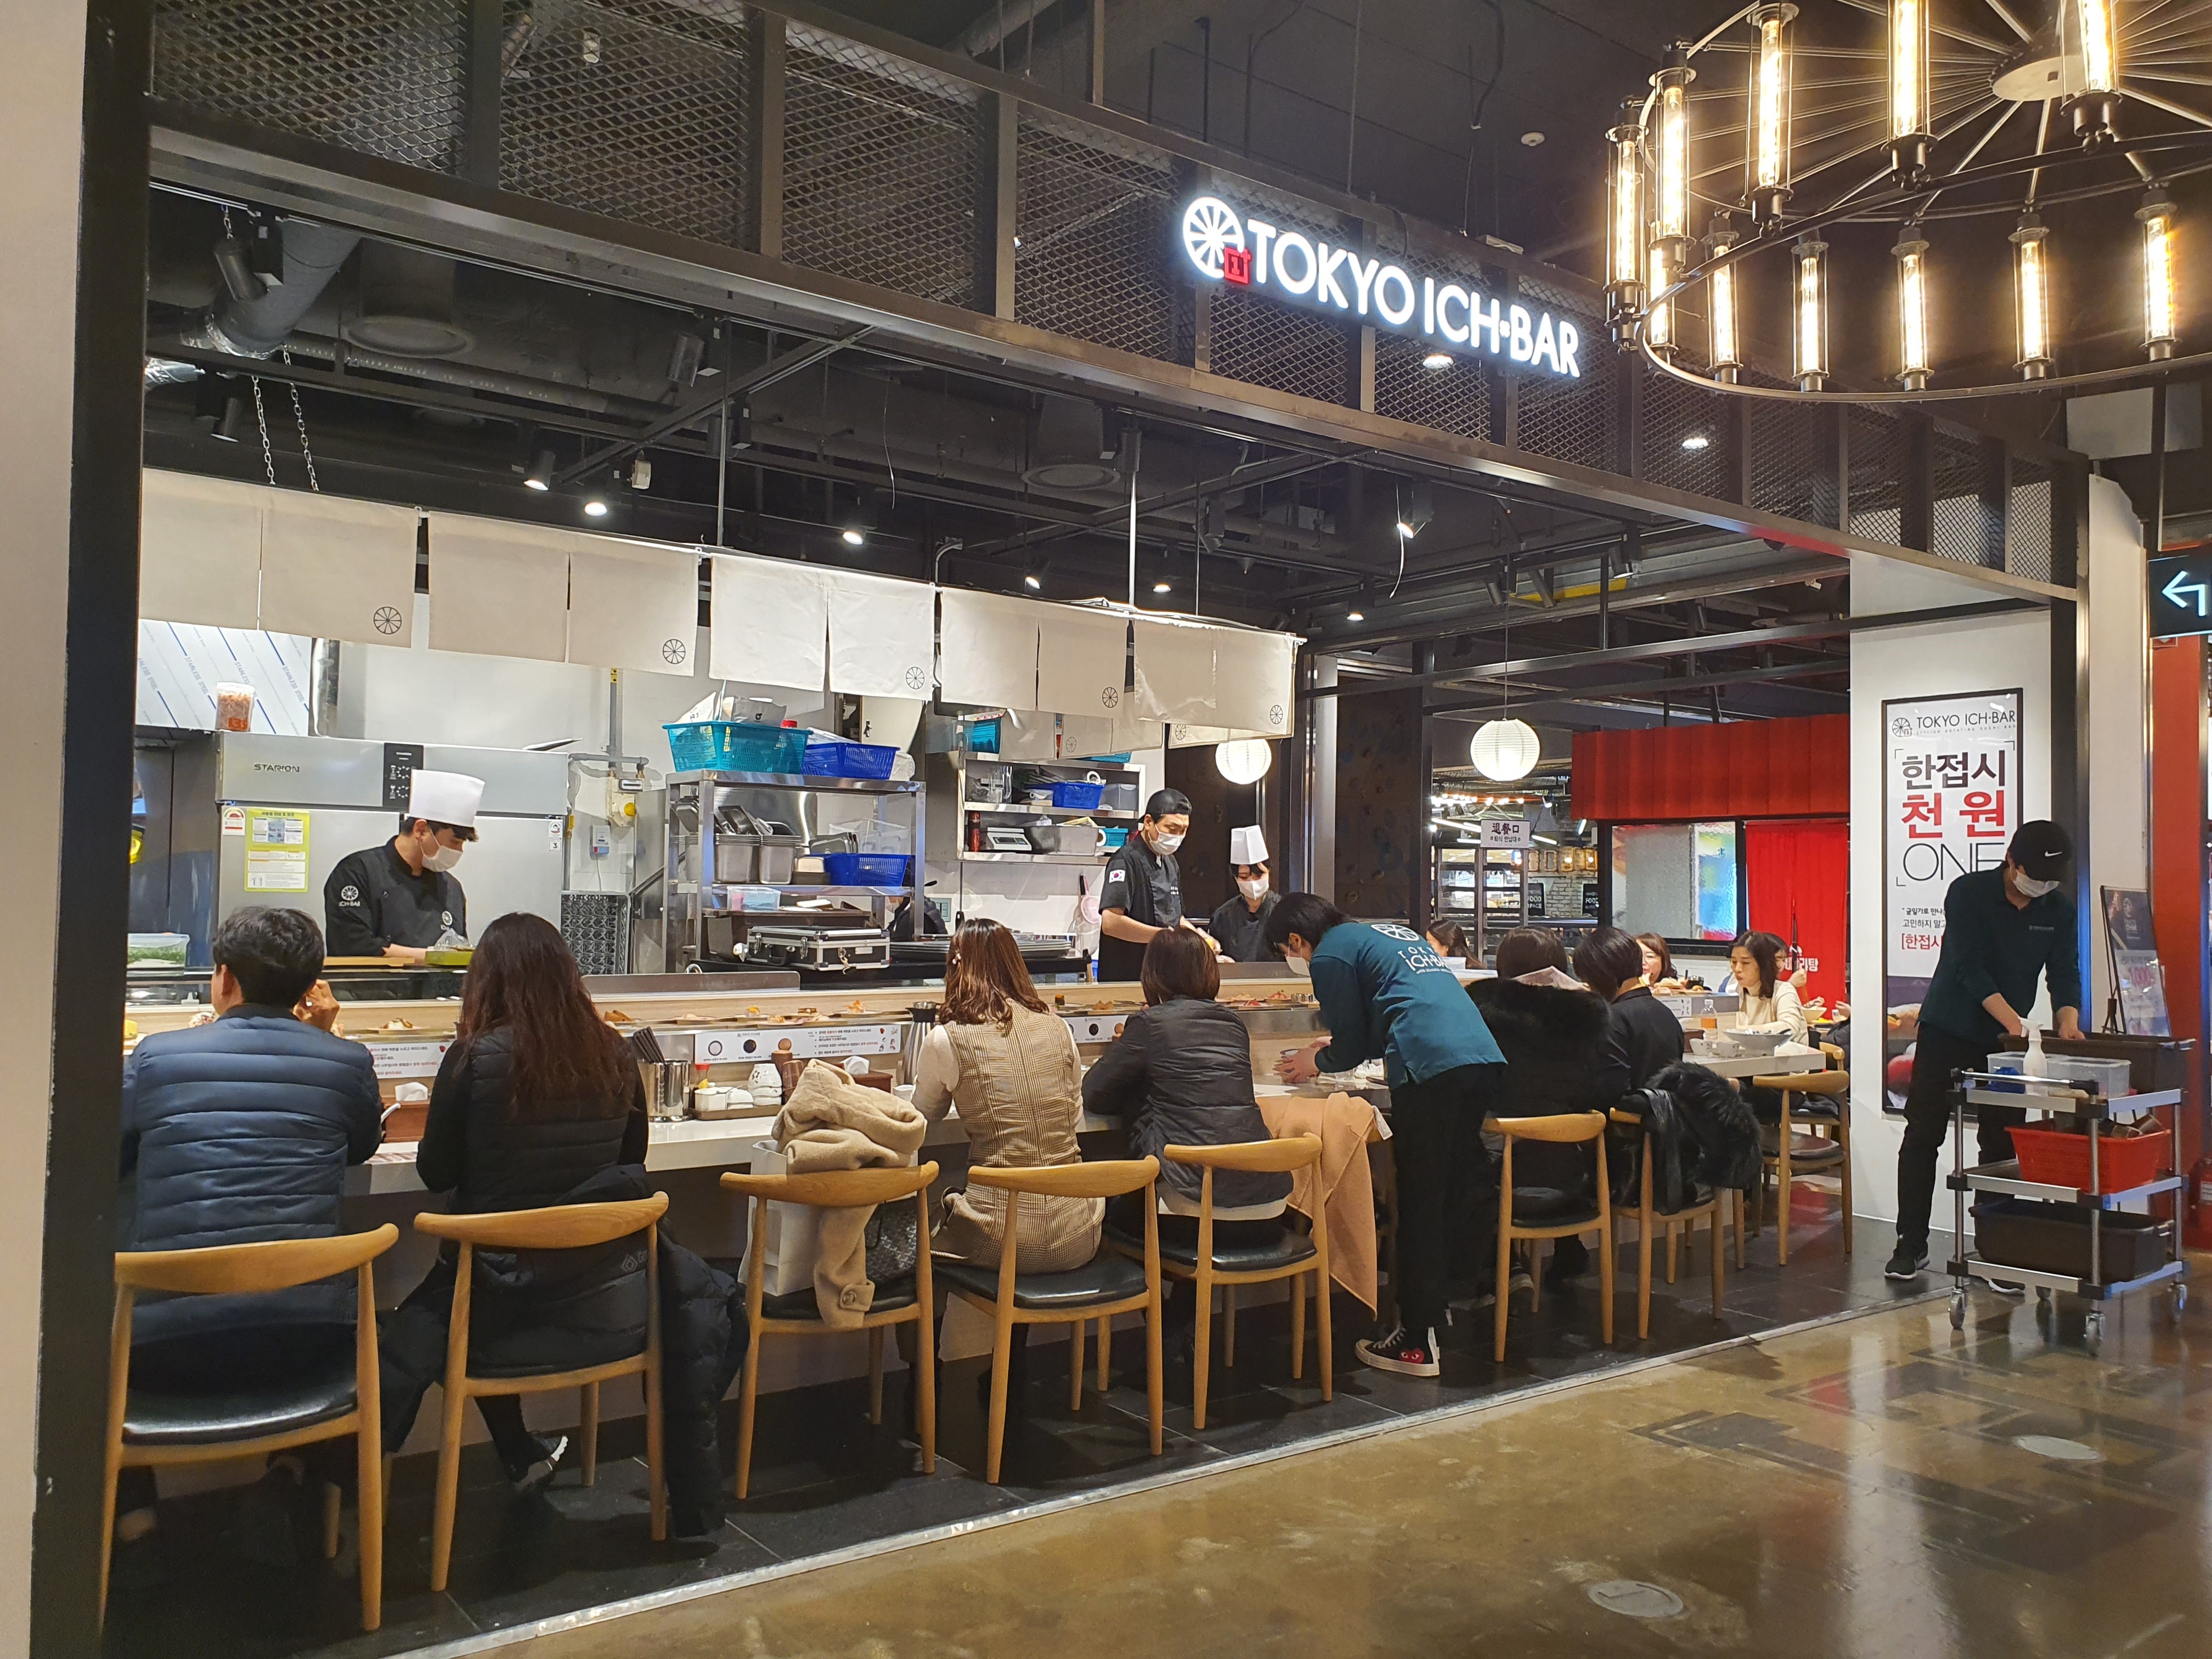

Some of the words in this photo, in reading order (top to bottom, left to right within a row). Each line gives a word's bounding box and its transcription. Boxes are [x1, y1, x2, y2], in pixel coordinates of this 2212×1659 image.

[1247, 219, 1415, 325] TOKYO
[1916, 714, 1960, 729] TOKYO
[254, 764, 300, 772] STARION
[1901, 749, 2006, 790] 한접시
[1901, 792, 1943, 839] 천
[1959, 790, 2006, 838] 원
[1931, 907, 1945, 916] 만나
[1903, 919, 1931, 928] 고민하지
[1398, 946, 1436, 958] TOKY
